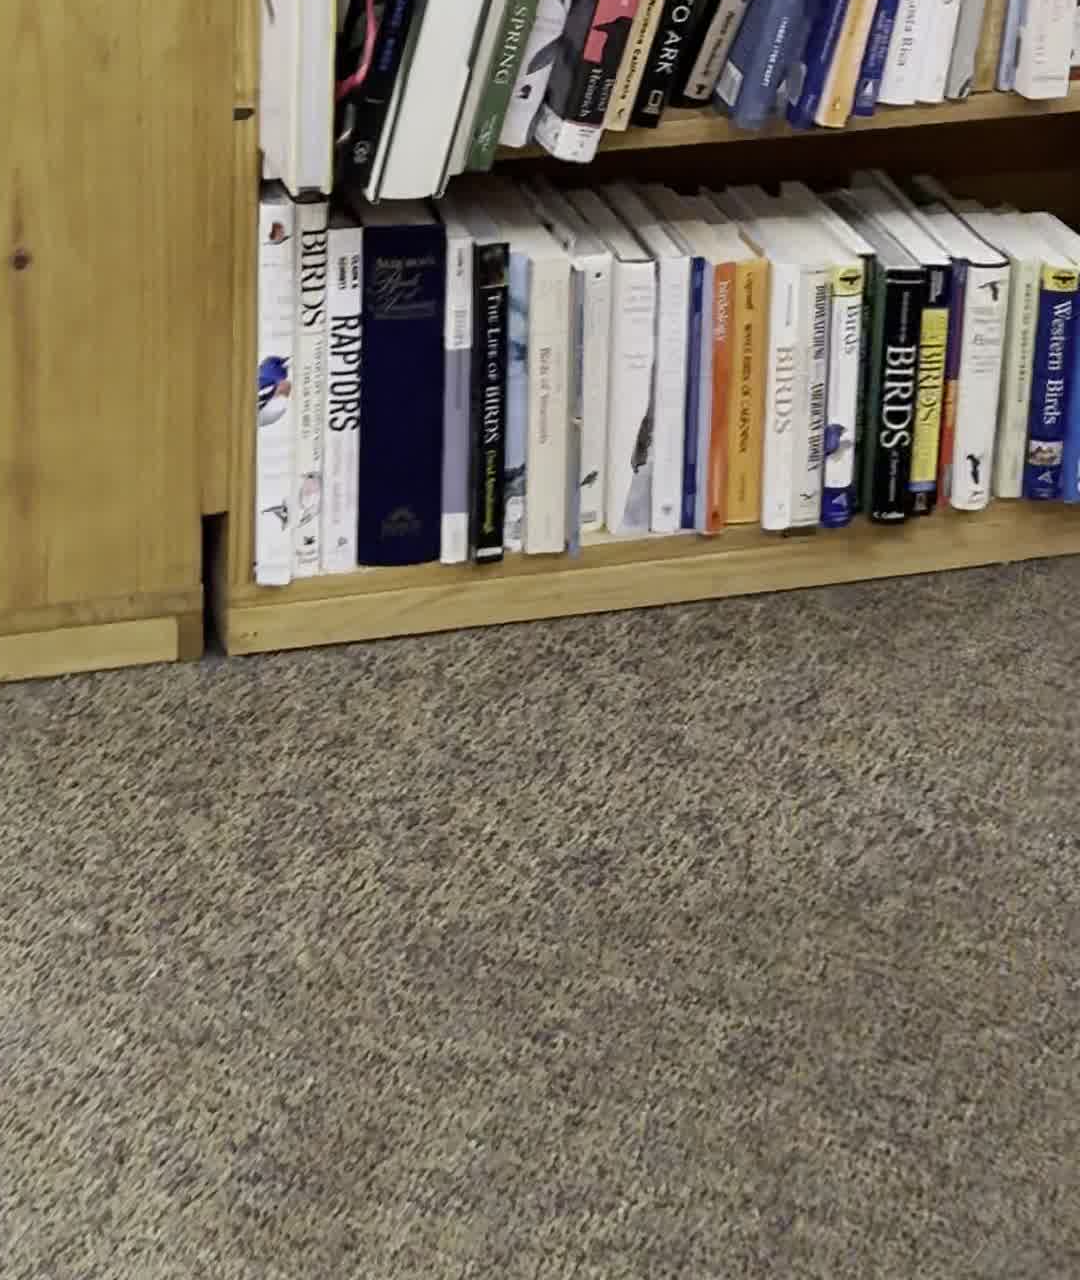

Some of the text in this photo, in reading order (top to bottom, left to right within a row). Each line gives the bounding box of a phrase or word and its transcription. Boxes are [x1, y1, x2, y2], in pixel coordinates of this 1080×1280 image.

[493, 5, 528, 85] SPRING
[636, 0, 659, 45] Northern
[654, 31, 682, 75] ARK
[620, 47, 645, 100] California
[300, 229, 329, 328] BIRDS
[487, 294, 501, 323] THE
[328, 314, 361, 432] RAPTORS
[486, 327, 500, 358] LIFE
[1043, 300, 1072, 425] Western Birds
[483, 385, 501, 445] BIRDS
[774, 346, 795, 435] BIRDS
[879, 344, 917, 450] BIRDS
